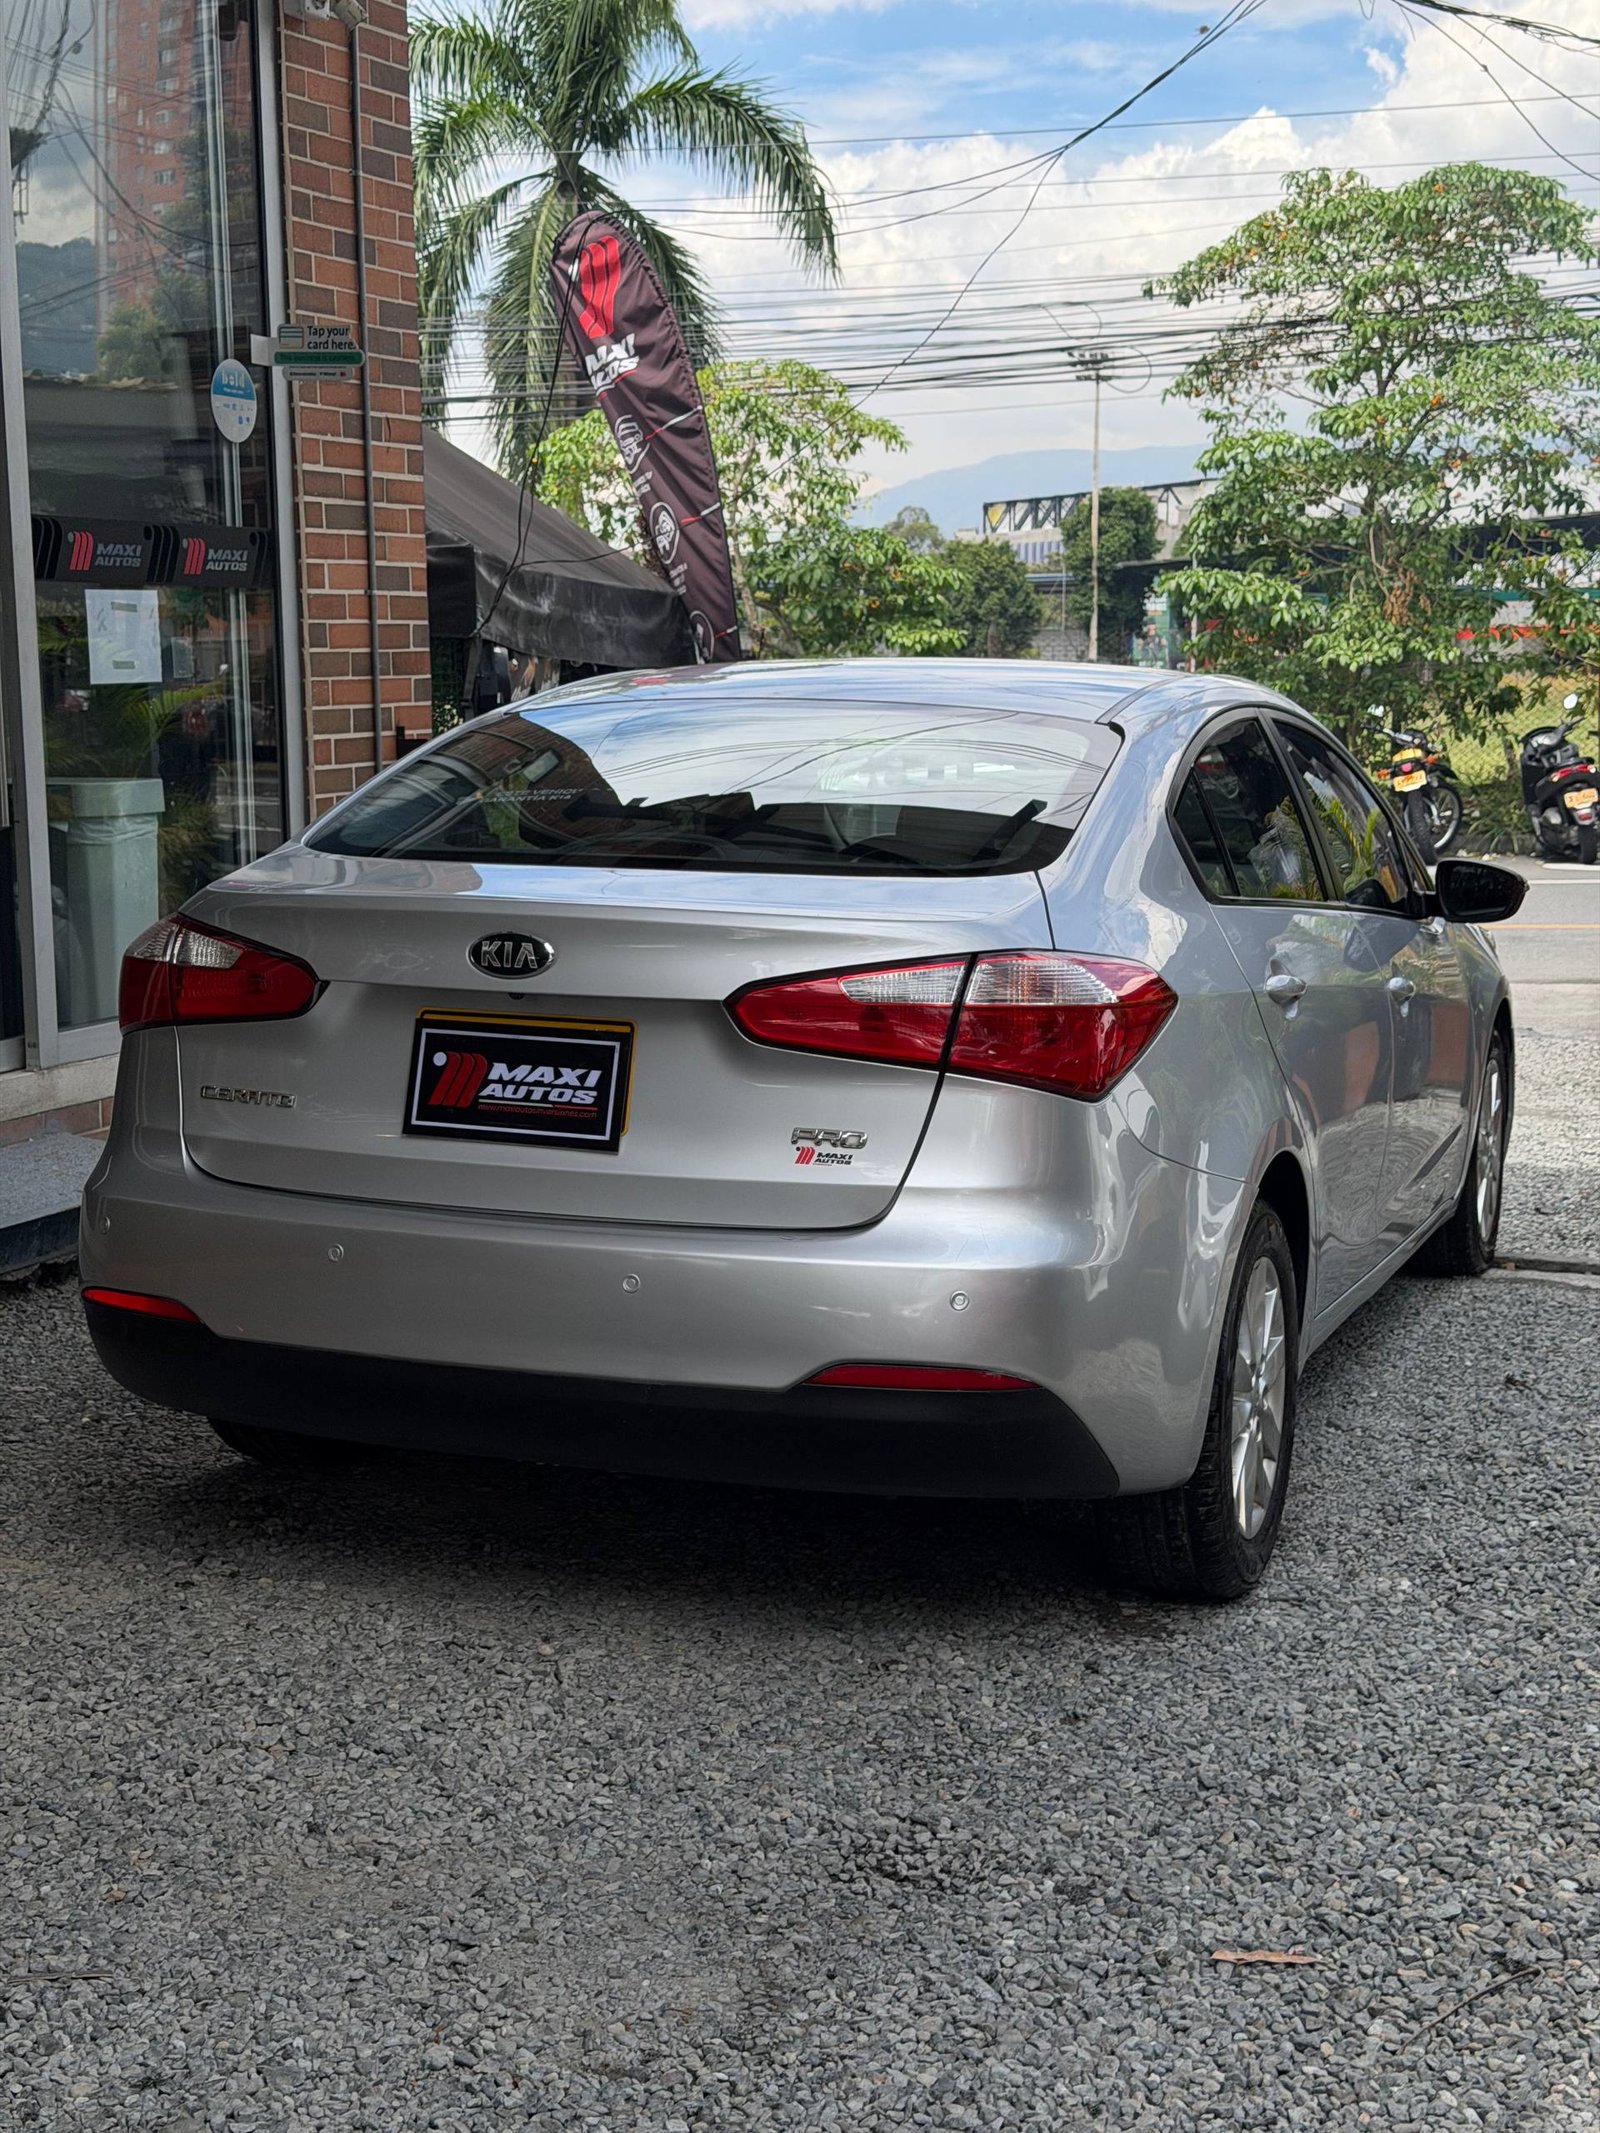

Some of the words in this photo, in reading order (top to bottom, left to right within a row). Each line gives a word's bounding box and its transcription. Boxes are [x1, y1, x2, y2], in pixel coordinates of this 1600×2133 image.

[307, 326, 325, 338] Tap
[326, 327, 350, 338] your
[307, 339, 330, 350] card
[222, 370, 245, 388] bold
[96, 543, 142, 556] MAXI
[207, 549, 248, 561] MAXI
[94, 556, 142, 568] AUTOS
[205, 561, 248, 572] AUTOS
[481, 940, 538, 969] KIA
[487, 1062, 603, 1088] MAXI
[200, 1085, 298, 1108] CERATO
[478, 1083, 598, 1105] AUTOS
[791, 1127, 869, 1149] PRO
[817, 1152, 853, 1160] MAXI
